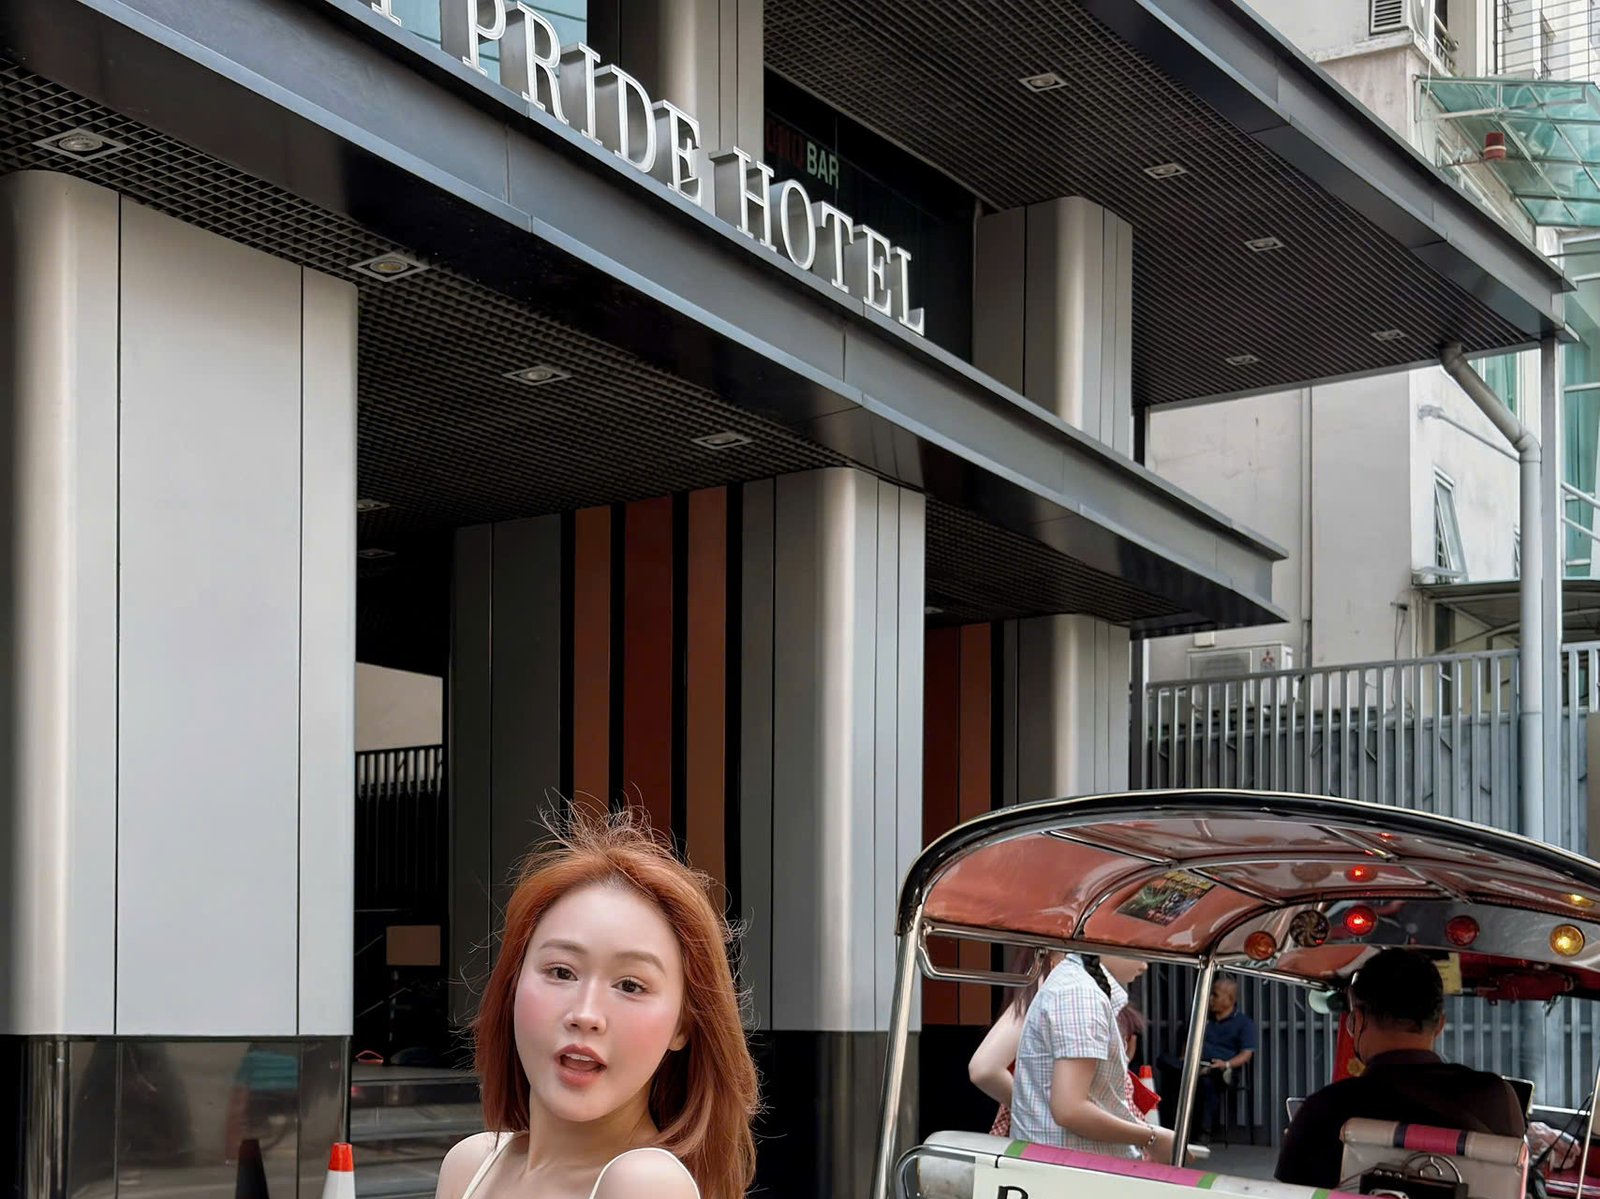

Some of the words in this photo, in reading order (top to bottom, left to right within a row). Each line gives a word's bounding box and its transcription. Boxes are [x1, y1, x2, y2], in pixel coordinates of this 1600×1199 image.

[462, 0, 702, 207] PRIDE
[733, 146, 925, 336] HOTEL
[806, 141, 840, 190] BAR
